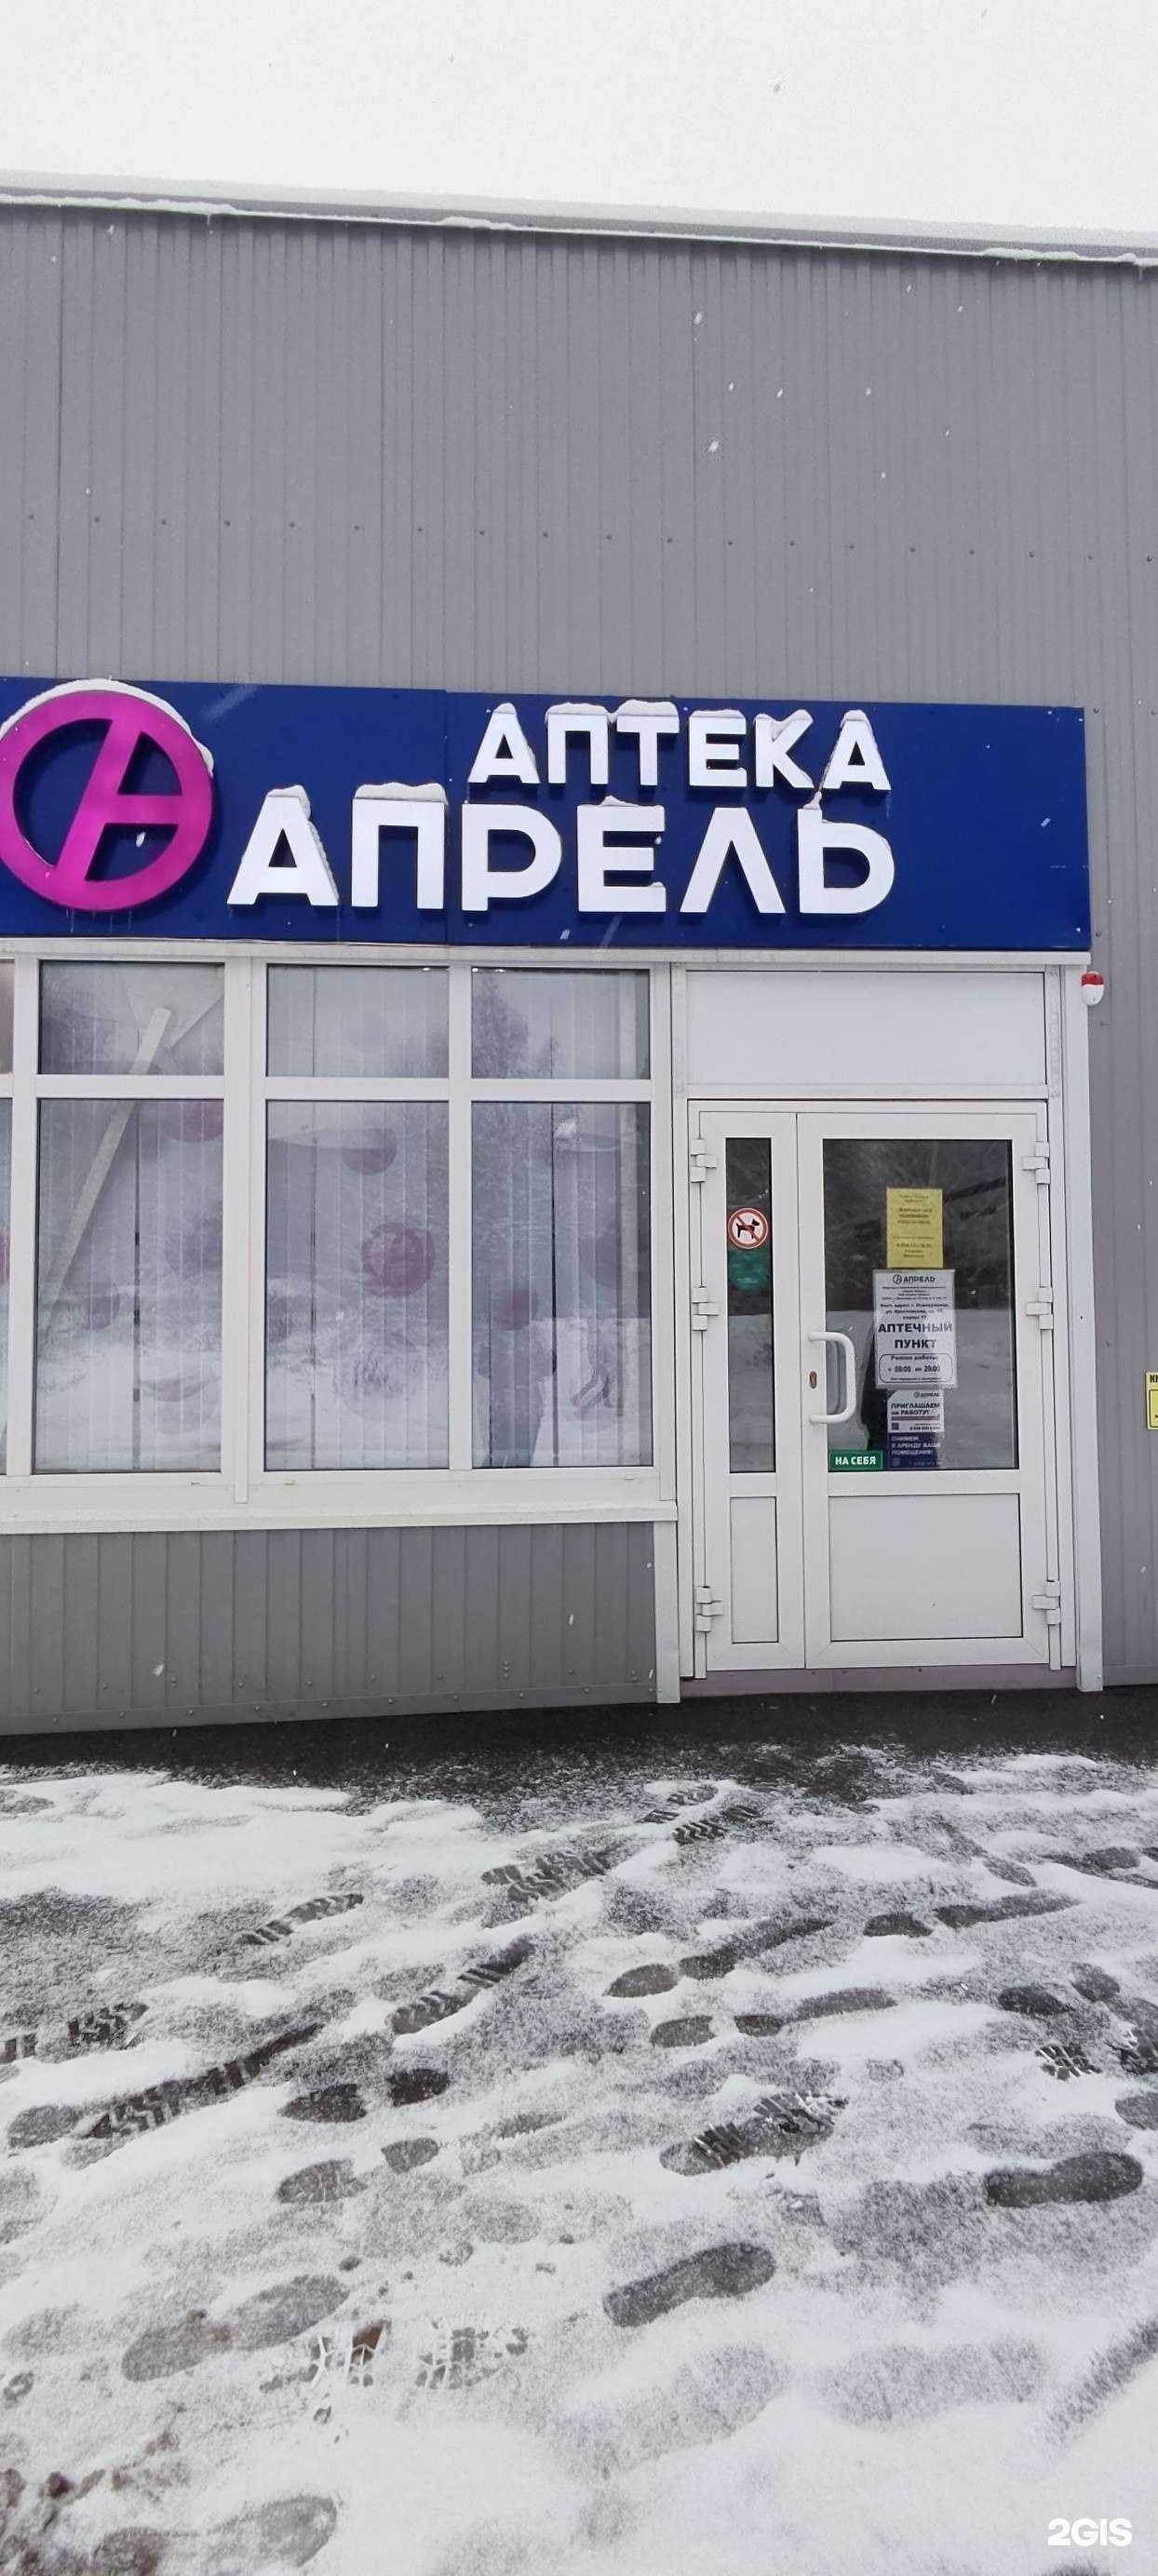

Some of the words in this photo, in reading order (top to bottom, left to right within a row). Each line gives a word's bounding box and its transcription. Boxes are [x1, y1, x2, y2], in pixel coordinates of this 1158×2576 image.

[468, 705, 891, 791] АПТЕКА
[226, 793, 895, 916] АПРЕЛЬ
[878, 1322, 952, 1333] АПТЕЧНЫЙ
[895, 1339, 936, 1348] ПУНКТ
[835, 1456, 849, 1466] НА
[851, 1456, 876, 1465] СЕБЯ
